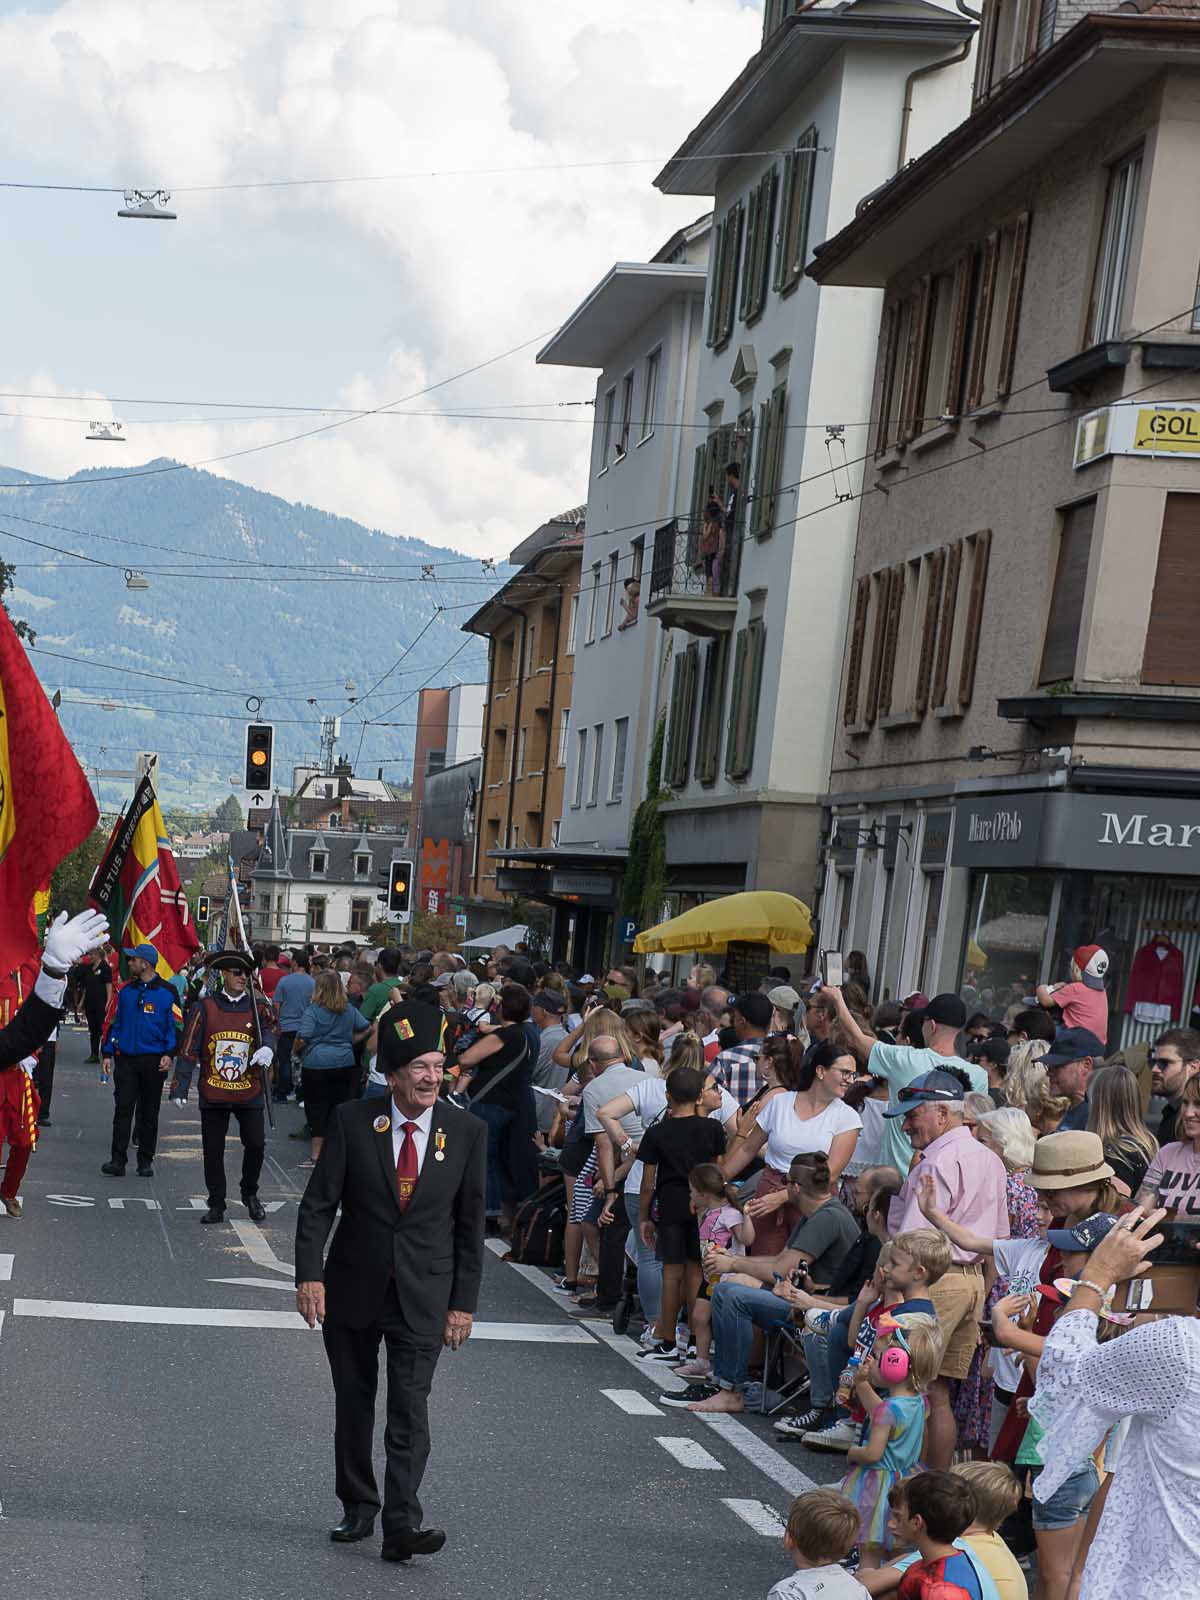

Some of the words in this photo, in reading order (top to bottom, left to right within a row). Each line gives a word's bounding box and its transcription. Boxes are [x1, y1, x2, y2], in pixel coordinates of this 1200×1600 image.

[968, 814, 991, 841] Marc
[99, 854, 123, 902] SATUS
[626, 921, 636, 937] P
